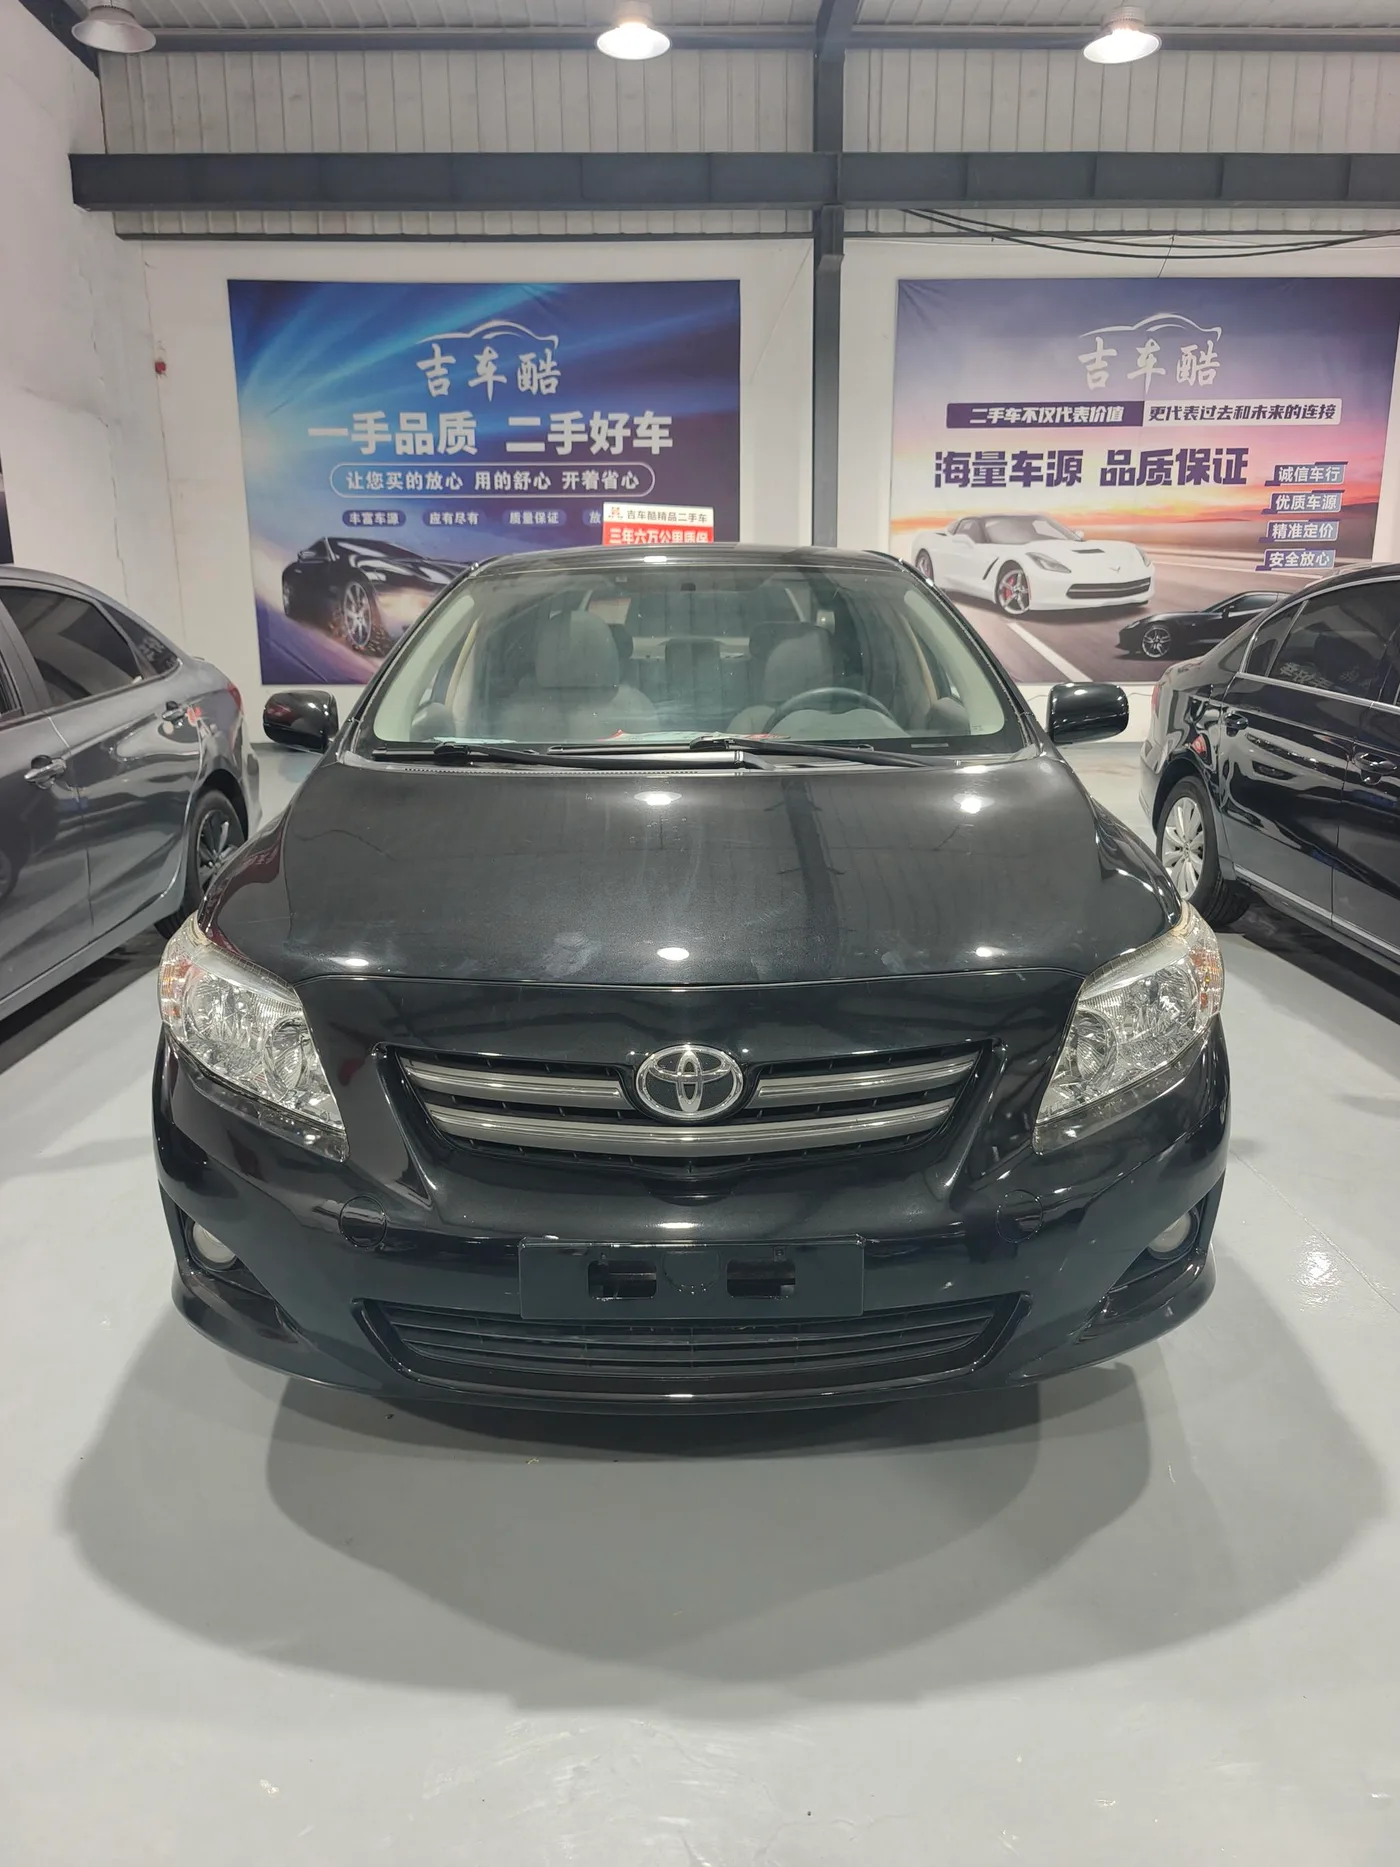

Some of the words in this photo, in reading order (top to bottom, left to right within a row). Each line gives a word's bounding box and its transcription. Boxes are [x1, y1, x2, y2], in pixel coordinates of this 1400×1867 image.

[416, 343, 561, 402] 吉车酷
[1078, 336, 1220, 395] 吉车酷
[969, 405, 1125, 424] 二手车不仅代表价值
[1148, 402, 1337, 422] 更代表过去和未来的连接
[308, 411, 478, 456] 一手品质
[506, 410, 674, 455] 二手好车
[934, 449, 1084, 488] 海量车源
[1099, 447, 1249, 486] 品质保证
[1279, 466, 1341, 482] 诚信车行
[346, 471, 464, 491] 让您买的放心
[475, 471, 552, 490] 用的舒心
[562, 471, 640, 490] 开着省心
[1276, 494, 1338, 510] 优质车源
[349, 512, 399, 525] 丰富车源
[429, 511, 479, 525] 应有尽有
[509, 511, 559, 525] 质量保证
[589, 510, 602, 524] 放
[627, 509, 708, 524] 吉车酷精品二手车
[1272, 523, 1334, 539] 精准定价
[1269, 551, 1330, 567] 安全放心
